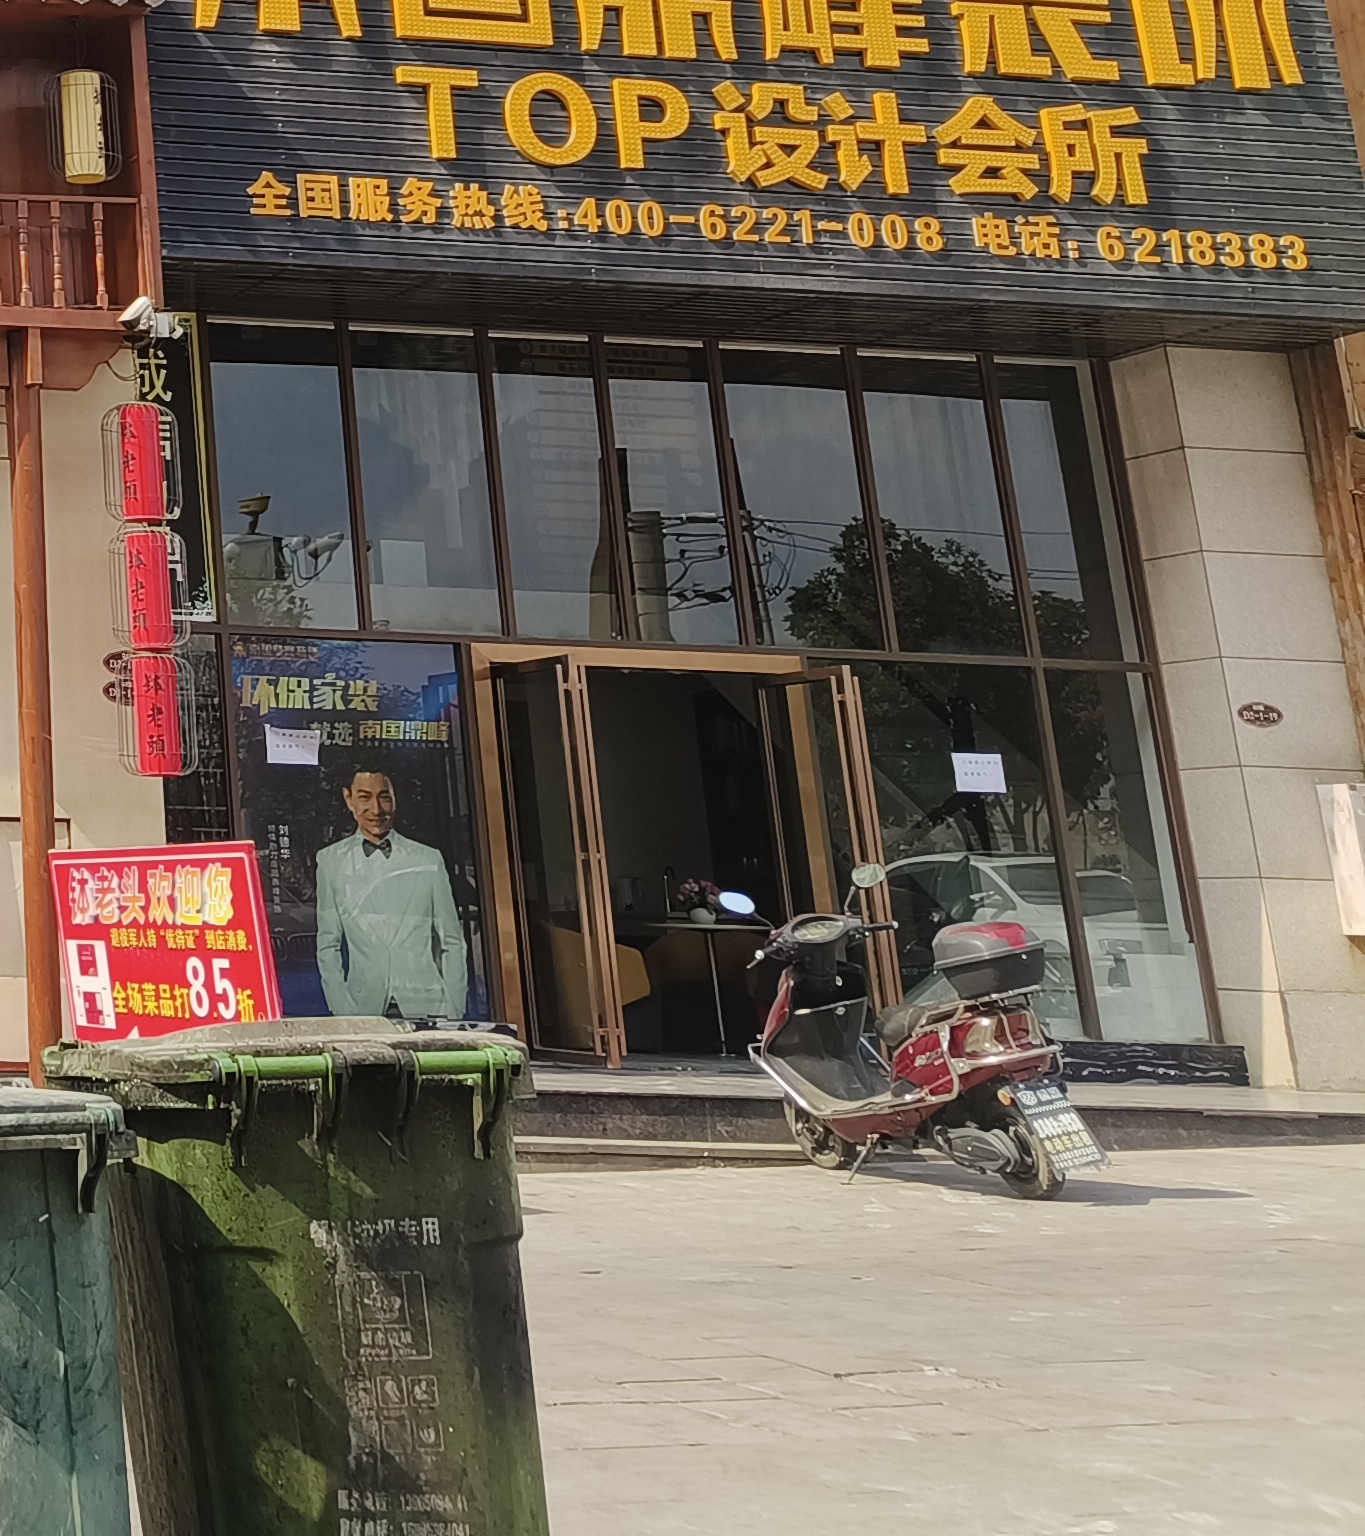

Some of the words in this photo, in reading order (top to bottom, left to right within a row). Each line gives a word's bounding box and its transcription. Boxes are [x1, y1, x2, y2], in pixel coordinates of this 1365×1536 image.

[394, 64, 693, 170] TOP
[711, 79, 1151, 208] 设计会所
[239, 672, 381, 717] 环保家装
[358, 719, 451, 742] 南国鼎峰
